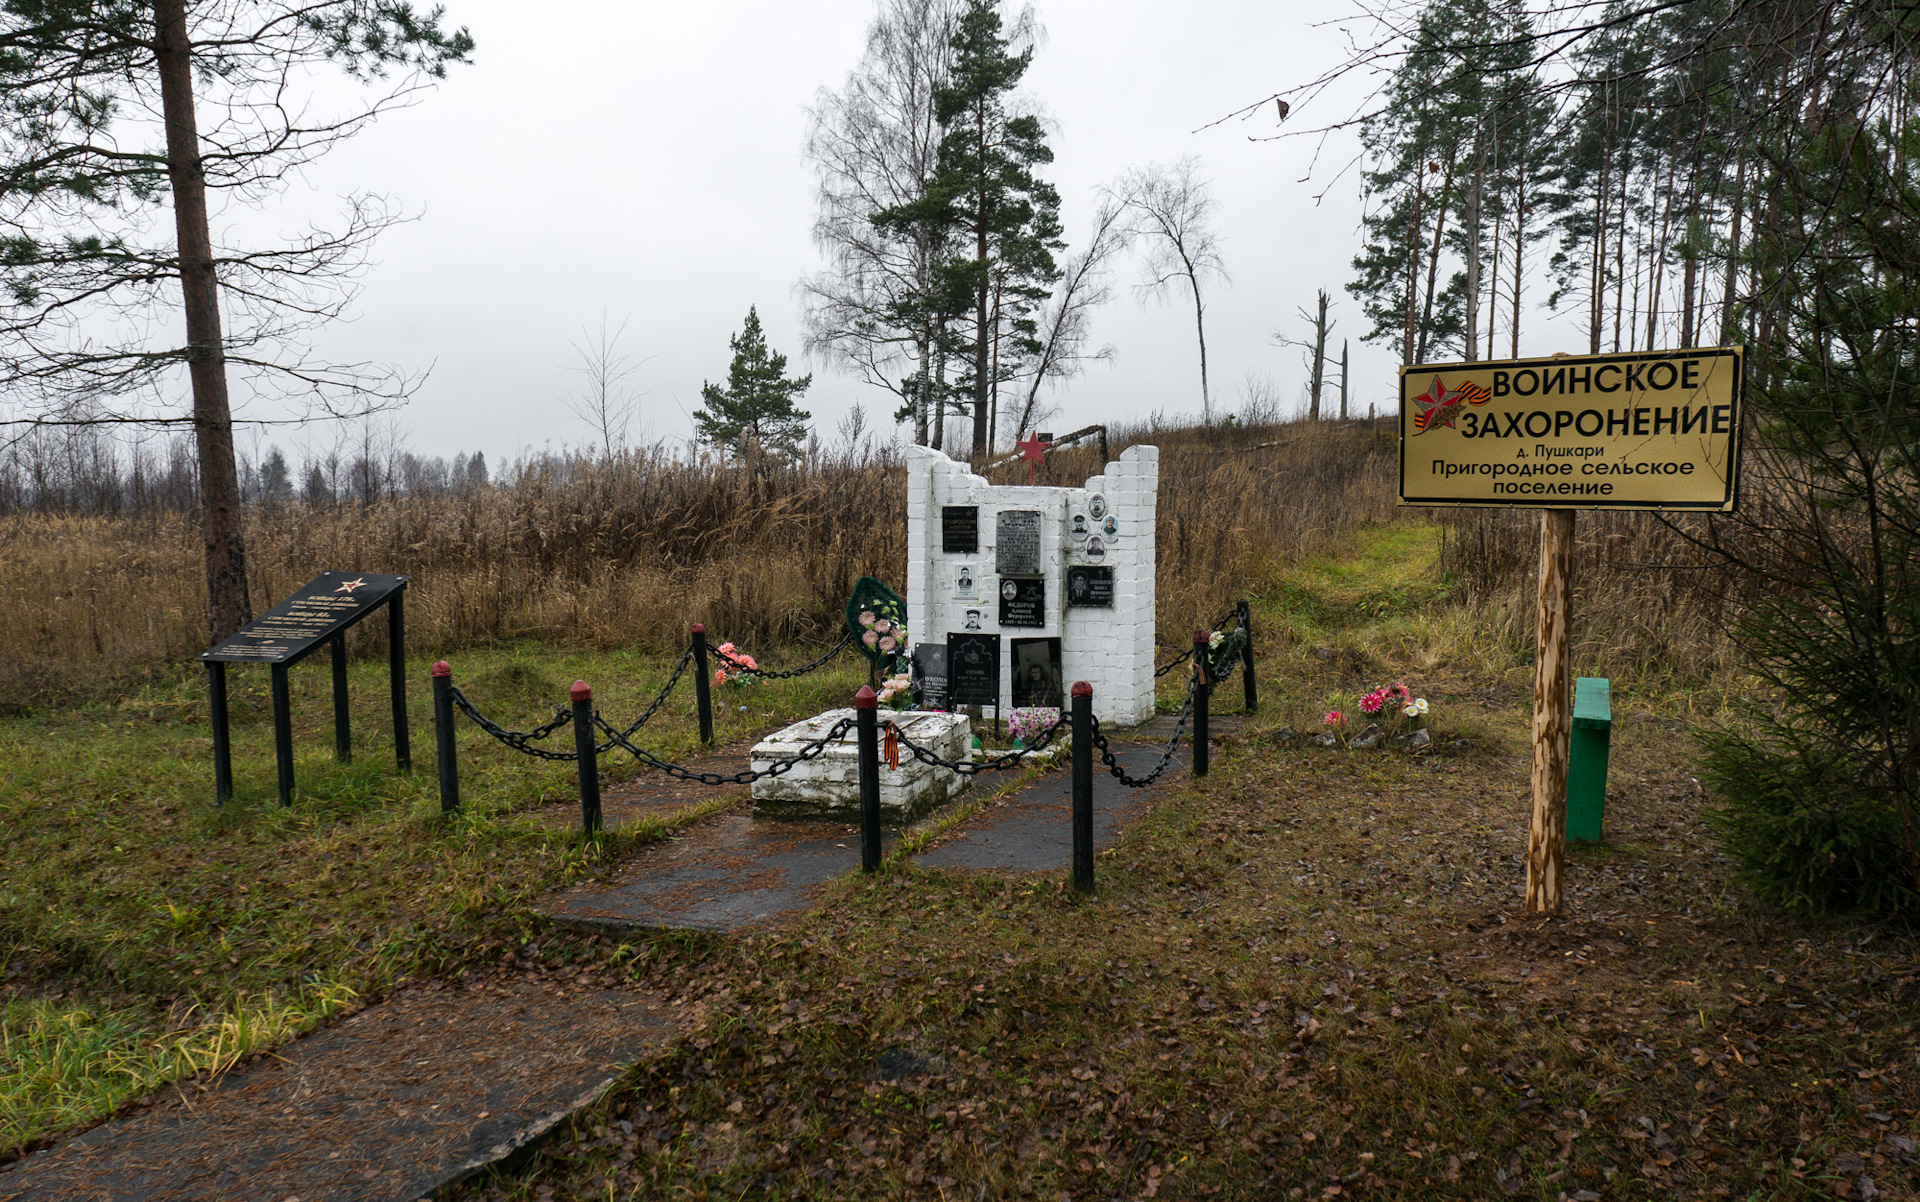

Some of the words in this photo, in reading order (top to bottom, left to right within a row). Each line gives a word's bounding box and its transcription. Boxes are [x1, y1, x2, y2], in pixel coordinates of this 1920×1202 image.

[1493, 360, 1700, 398] ВОИНСКОЕ
[1461, 404, 1731, 439] ЗАХОРОНЕНИЕ
[1516, 447, 1530, 459] д.
[1535, 444, 1605, 460] Пушкари
[1432, 460, 1573, 479] Пригородное
[1581, 461, 1695, 475] сельское
[1493, 481, 1614, 495] поселение
